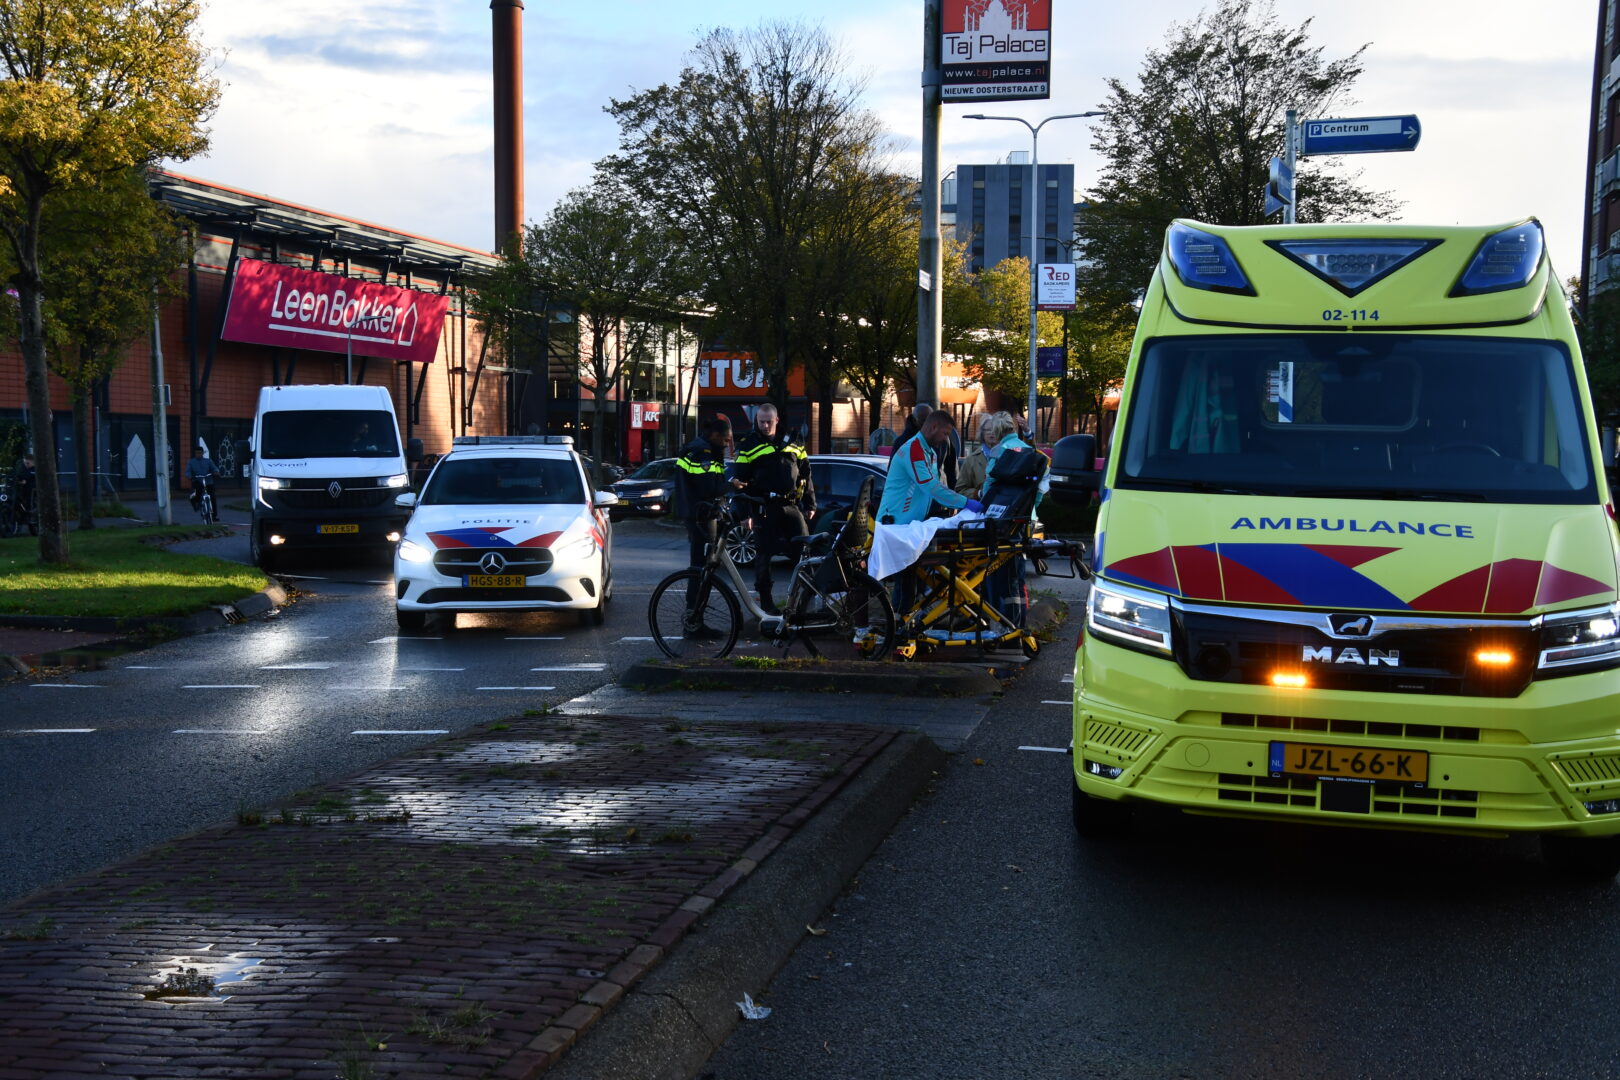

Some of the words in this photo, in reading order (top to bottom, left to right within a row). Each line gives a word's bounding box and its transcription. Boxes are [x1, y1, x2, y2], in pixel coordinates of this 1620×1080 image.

[945, 35, 973, 60] Taj
[979, 34, 1046, 54] Palace
[945, 66, 1045, 79] www.tajpalace.nl
[944, 87, 974, 95] NIEUWE
[976, 85, 1038, 94] OOSTERSTRAAT
[1323, 124, 1369, 133] Centrum
[1043, 266, 1070, 281] RED
[271, 280, 403, 334] LeenBakker
[1322, 309, 1380, 321] 02-114
[644, 411, 660, 423] KFC
[1230, 517, 1475, 539] AMBULANCE
[470, 575, 522, 586] HGS-88-R
[1302, 645, 1400, 667] MAN
[1294, 748, 1412, 778] JZL-66-K
